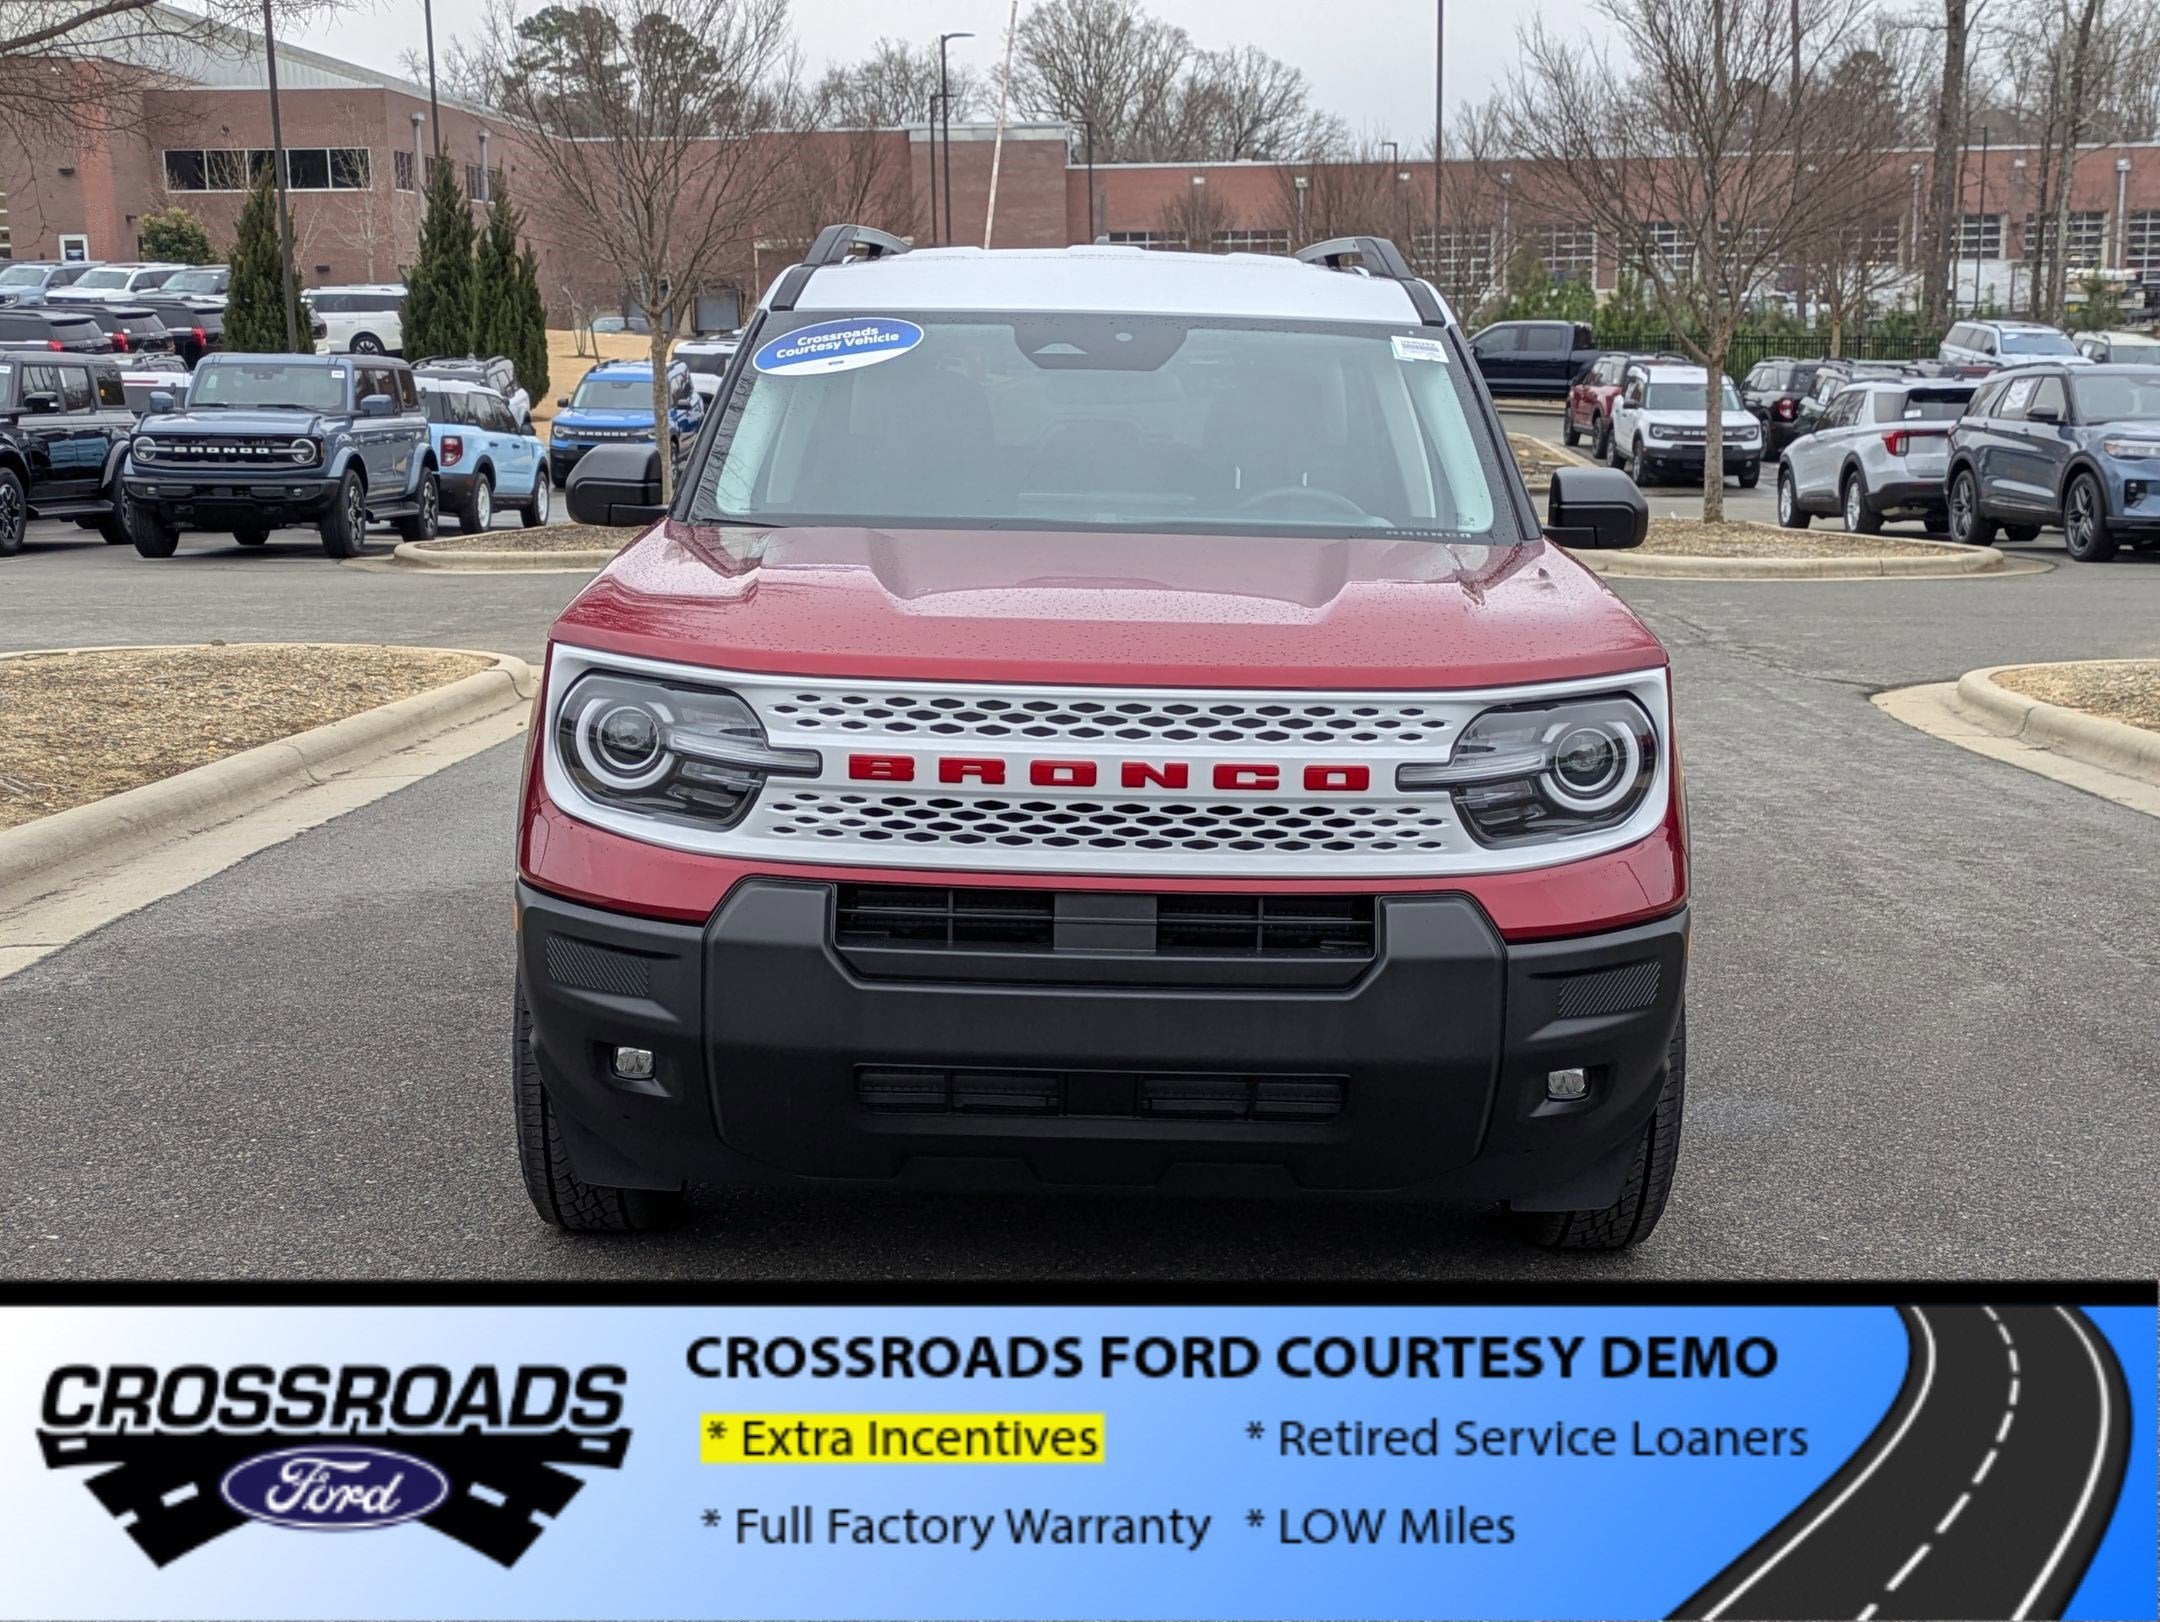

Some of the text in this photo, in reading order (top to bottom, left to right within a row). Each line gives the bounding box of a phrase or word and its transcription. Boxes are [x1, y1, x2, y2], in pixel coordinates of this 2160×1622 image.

[776, 332, 900, 359] Courtesy Vehicle
[796, 327, 880, 346] Crossroads
[173, 446, 270, 455] BRONCO
[848, 753, 1371, 792] BRONCO
